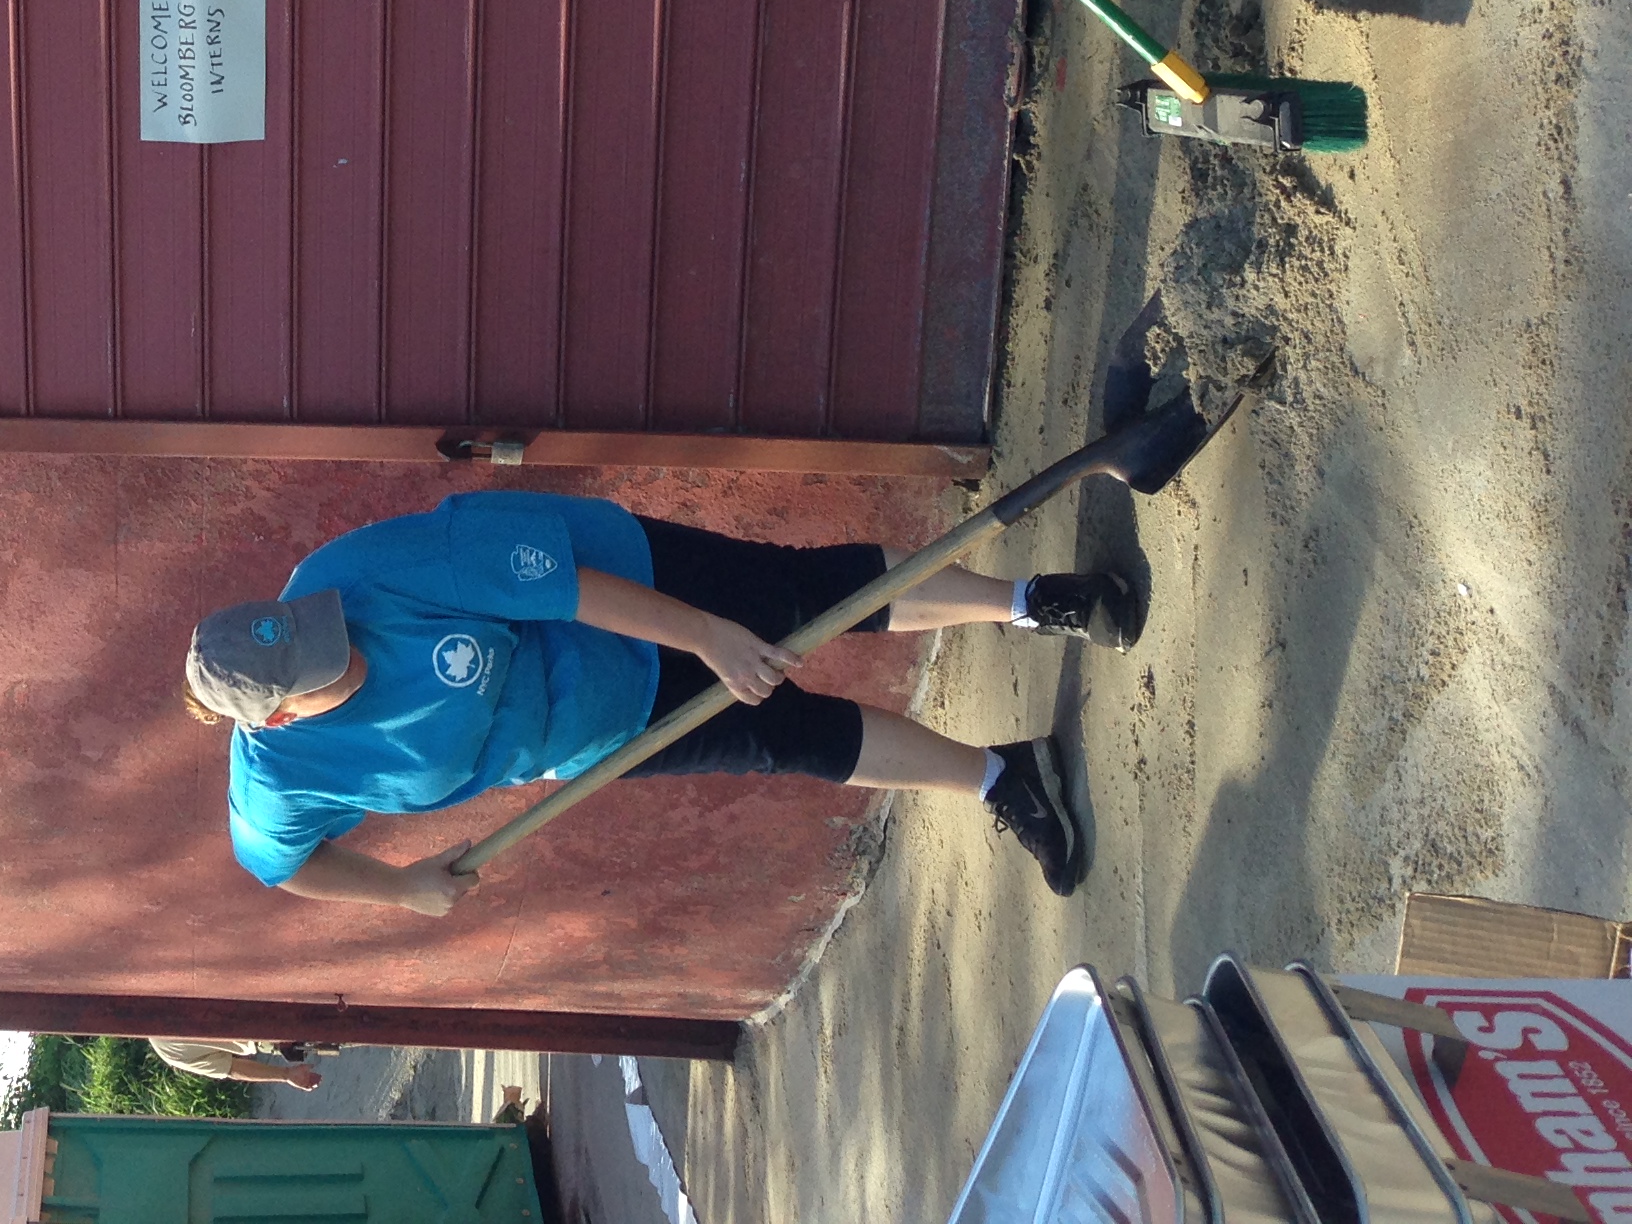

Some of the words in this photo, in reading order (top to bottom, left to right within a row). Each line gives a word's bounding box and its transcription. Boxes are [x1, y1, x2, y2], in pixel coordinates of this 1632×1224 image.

[151, 0, 171, 113] WELCOME
[177, 2, 197, 126] BLOOMBERG
[206, 5, 225, 94] INTERNS
[476, 676, 490, 696] NYC
[484, 647, 495, 675] Parks
[1569, 1060, 1609, 1094] 1852
